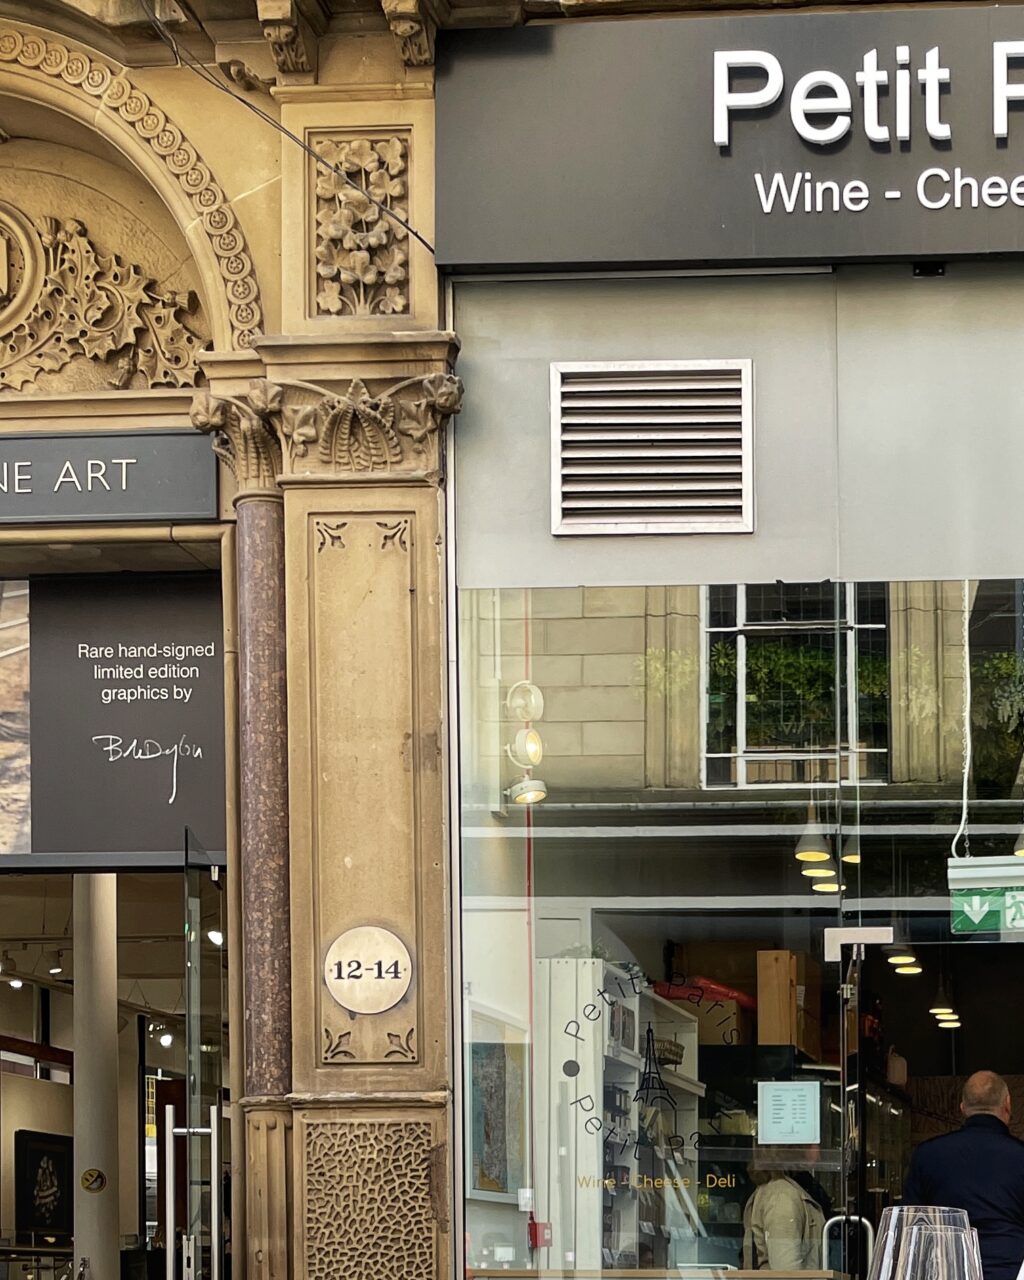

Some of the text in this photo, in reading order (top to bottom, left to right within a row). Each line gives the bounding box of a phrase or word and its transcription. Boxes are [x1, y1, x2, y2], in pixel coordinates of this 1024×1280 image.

[713, 46, 951, 146] Petit
[754, 172, 869, 213] Wine
[884, 190, 901, 199] -
[53, 459, 137, 492] ART
[78, 642, 215, 660] Rare hand-signed
[94, 664, 199, 679] limited edition
[101, 685, 193, 703] graphics by
[334, 960, 402, 980] 12-14
[564, 971, 741, 1046] Petit Paris
[570, 1094, 642, 1161] Petit
[577, 1174, 617, 1188] Wine
[633, 1174, 691, 1188] Cheese
[706, 1174, 737, 1188] Deli
